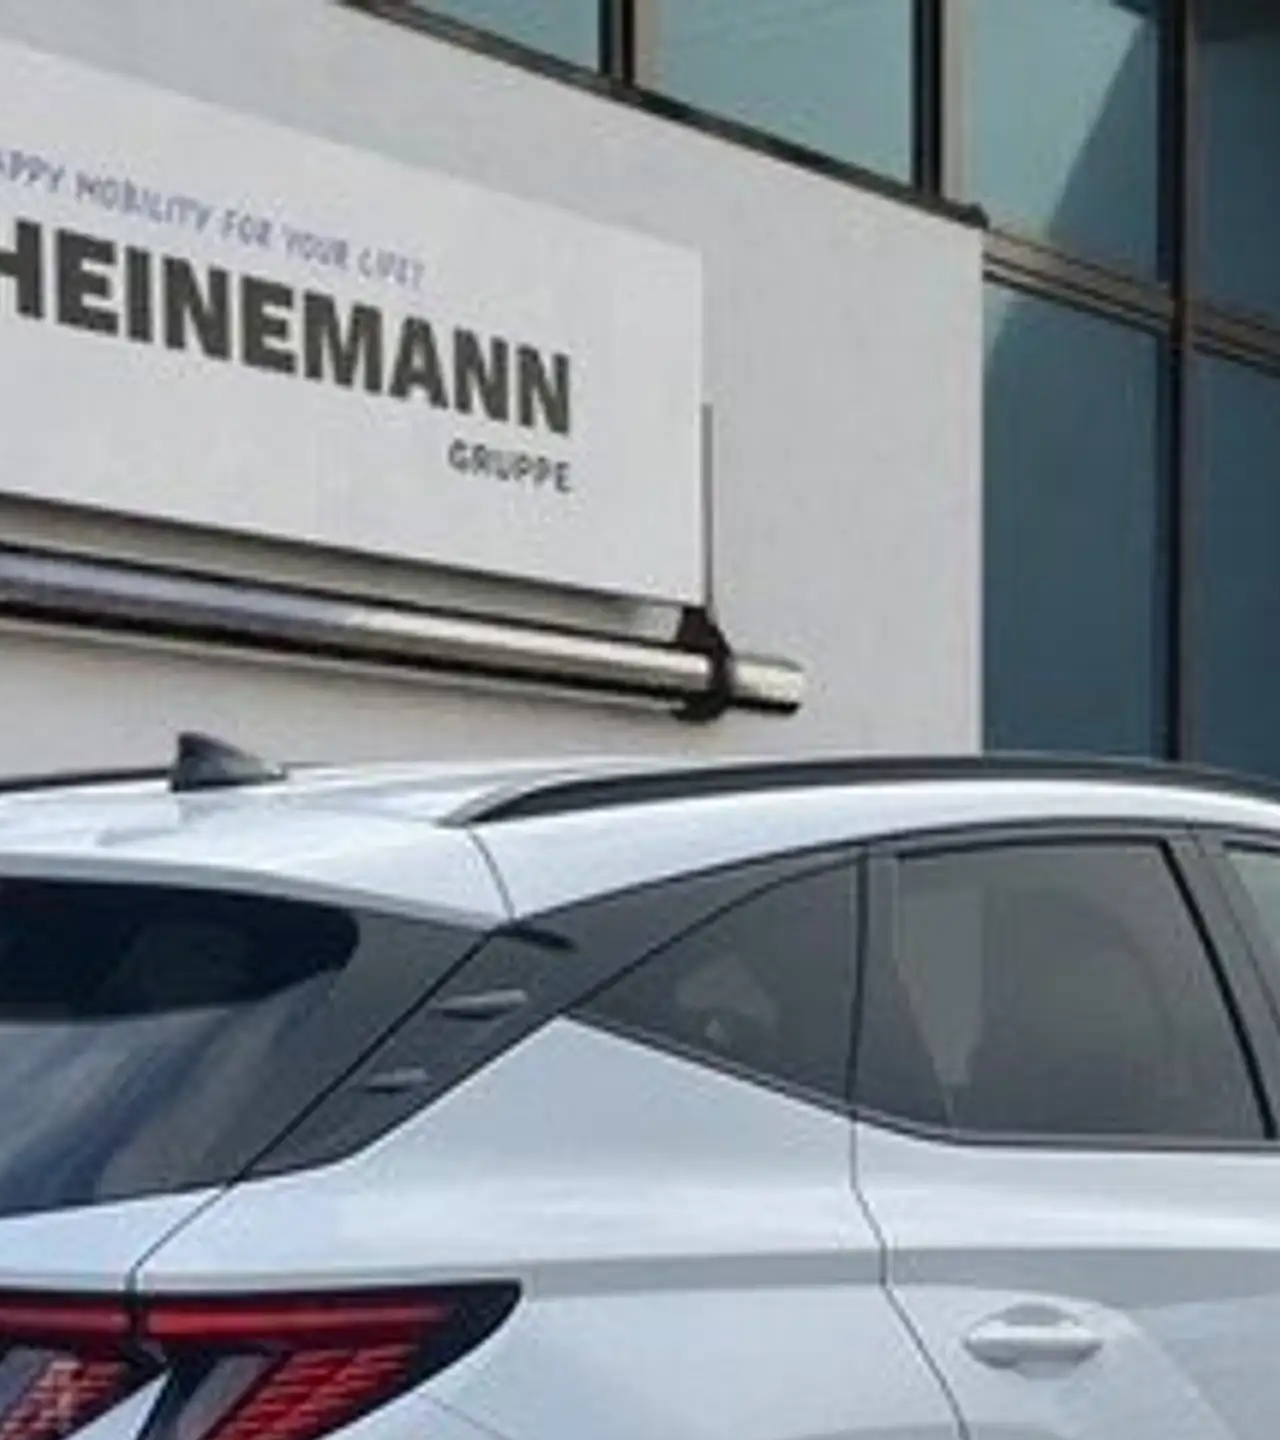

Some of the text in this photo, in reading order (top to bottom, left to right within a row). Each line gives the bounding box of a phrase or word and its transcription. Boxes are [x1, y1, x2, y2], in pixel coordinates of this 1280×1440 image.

[75, 171, 214, 234] MOBILITY
[222, 208, 272, 247] FOR
[281, 222, 349, 271] YOUR
[447, 439, 573, 494] GRUPPE
